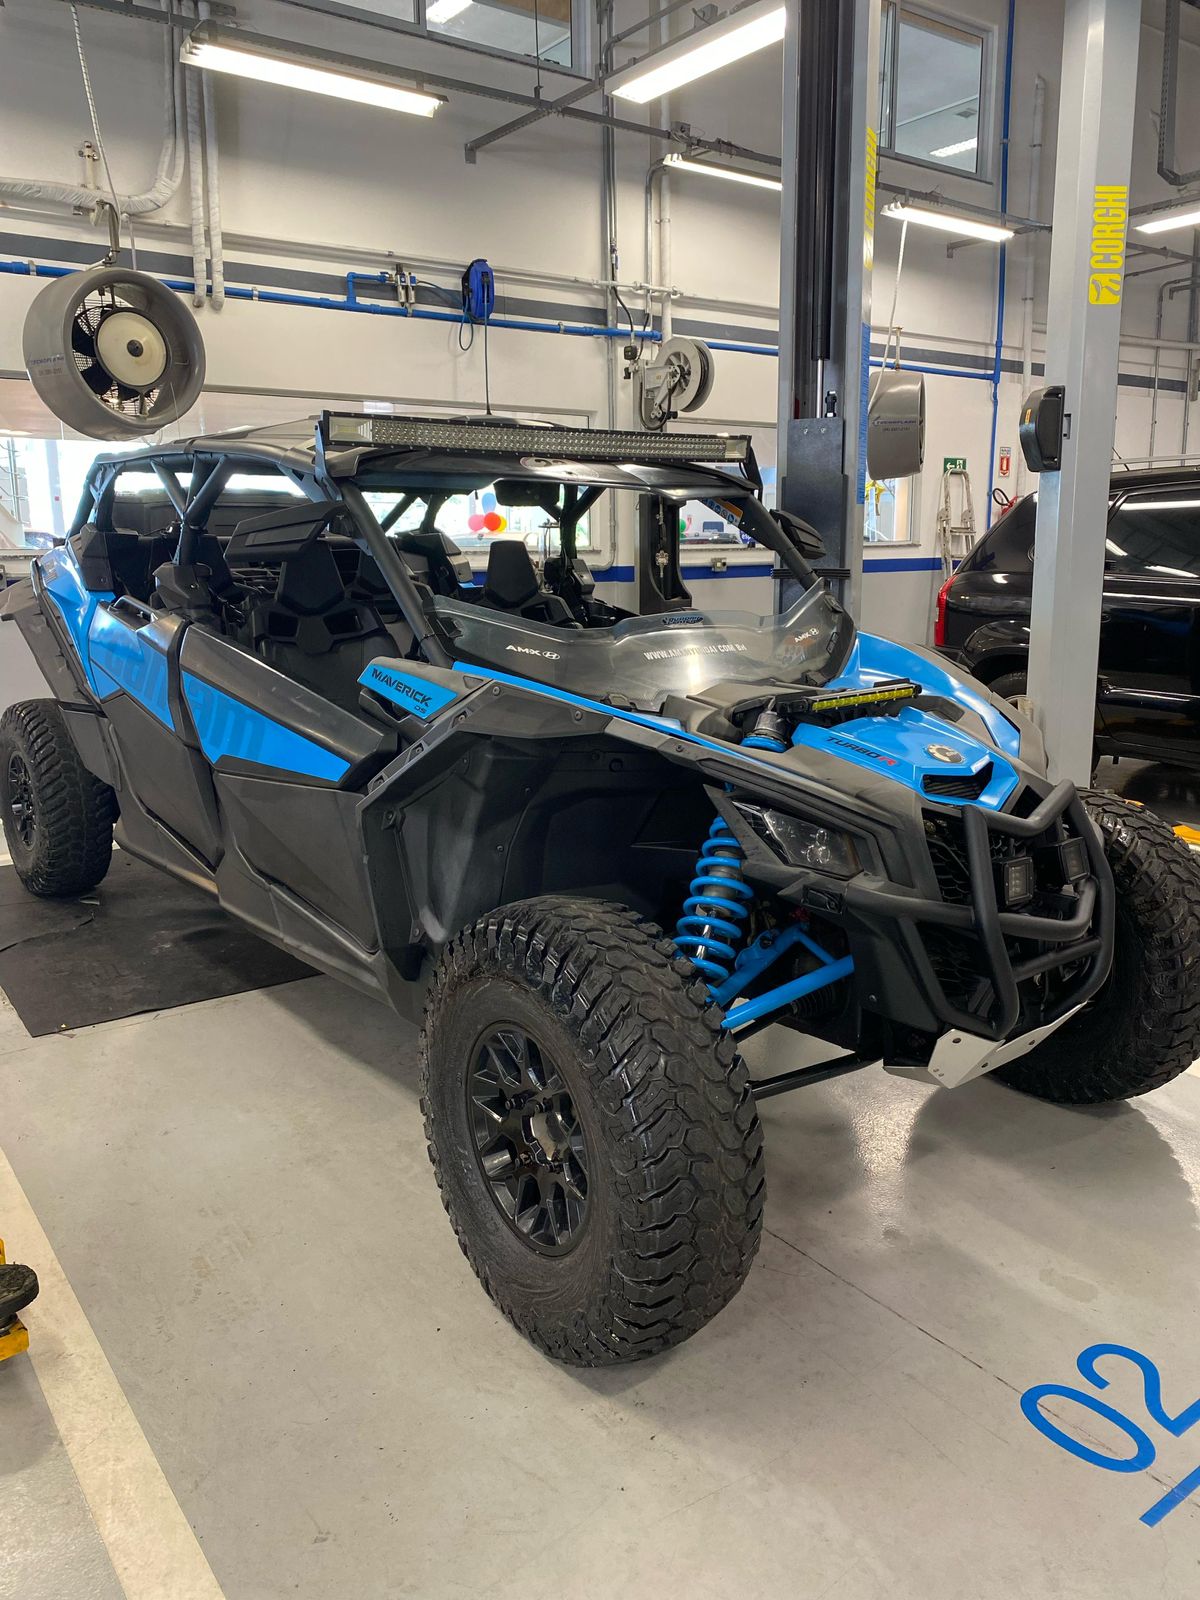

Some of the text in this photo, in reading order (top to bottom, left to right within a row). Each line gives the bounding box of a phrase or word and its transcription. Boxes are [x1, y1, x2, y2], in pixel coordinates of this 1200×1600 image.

[1089, 185, 1128, 269] CORGHI
[371, 668, 432, 707] MAVERICK
[1020, 1343, 1200, 1473] 02
